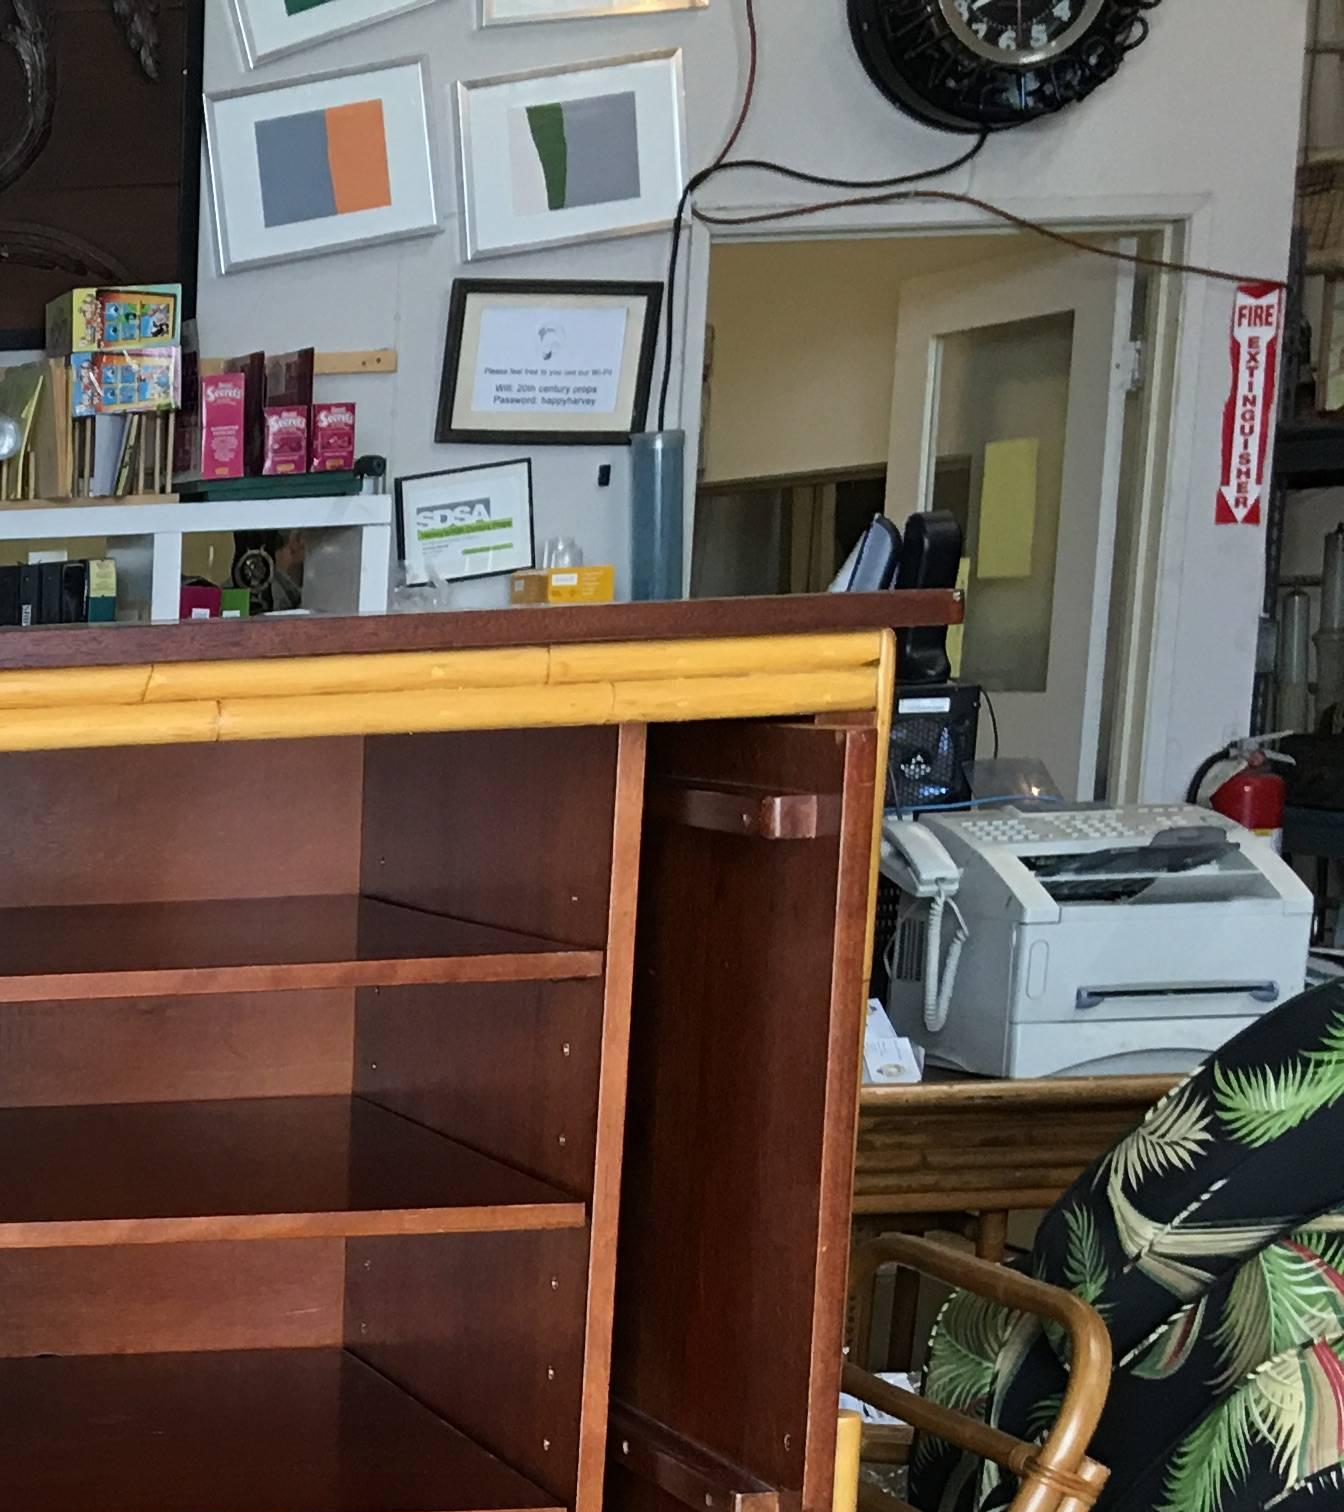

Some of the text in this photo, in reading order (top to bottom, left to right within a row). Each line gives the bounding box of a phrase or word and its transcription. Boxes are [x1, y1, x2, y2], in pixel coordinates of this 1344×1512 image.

[1237, 304, 1274, 327] FIRE
[516, 384, 536, 393] 20th
[538, 384, 571, 395] century
[572, 385, 598, 396] props
[1234, 336, 1260, 508] EXTINGUISHER
[416, 502, 492, 529] SDSA
